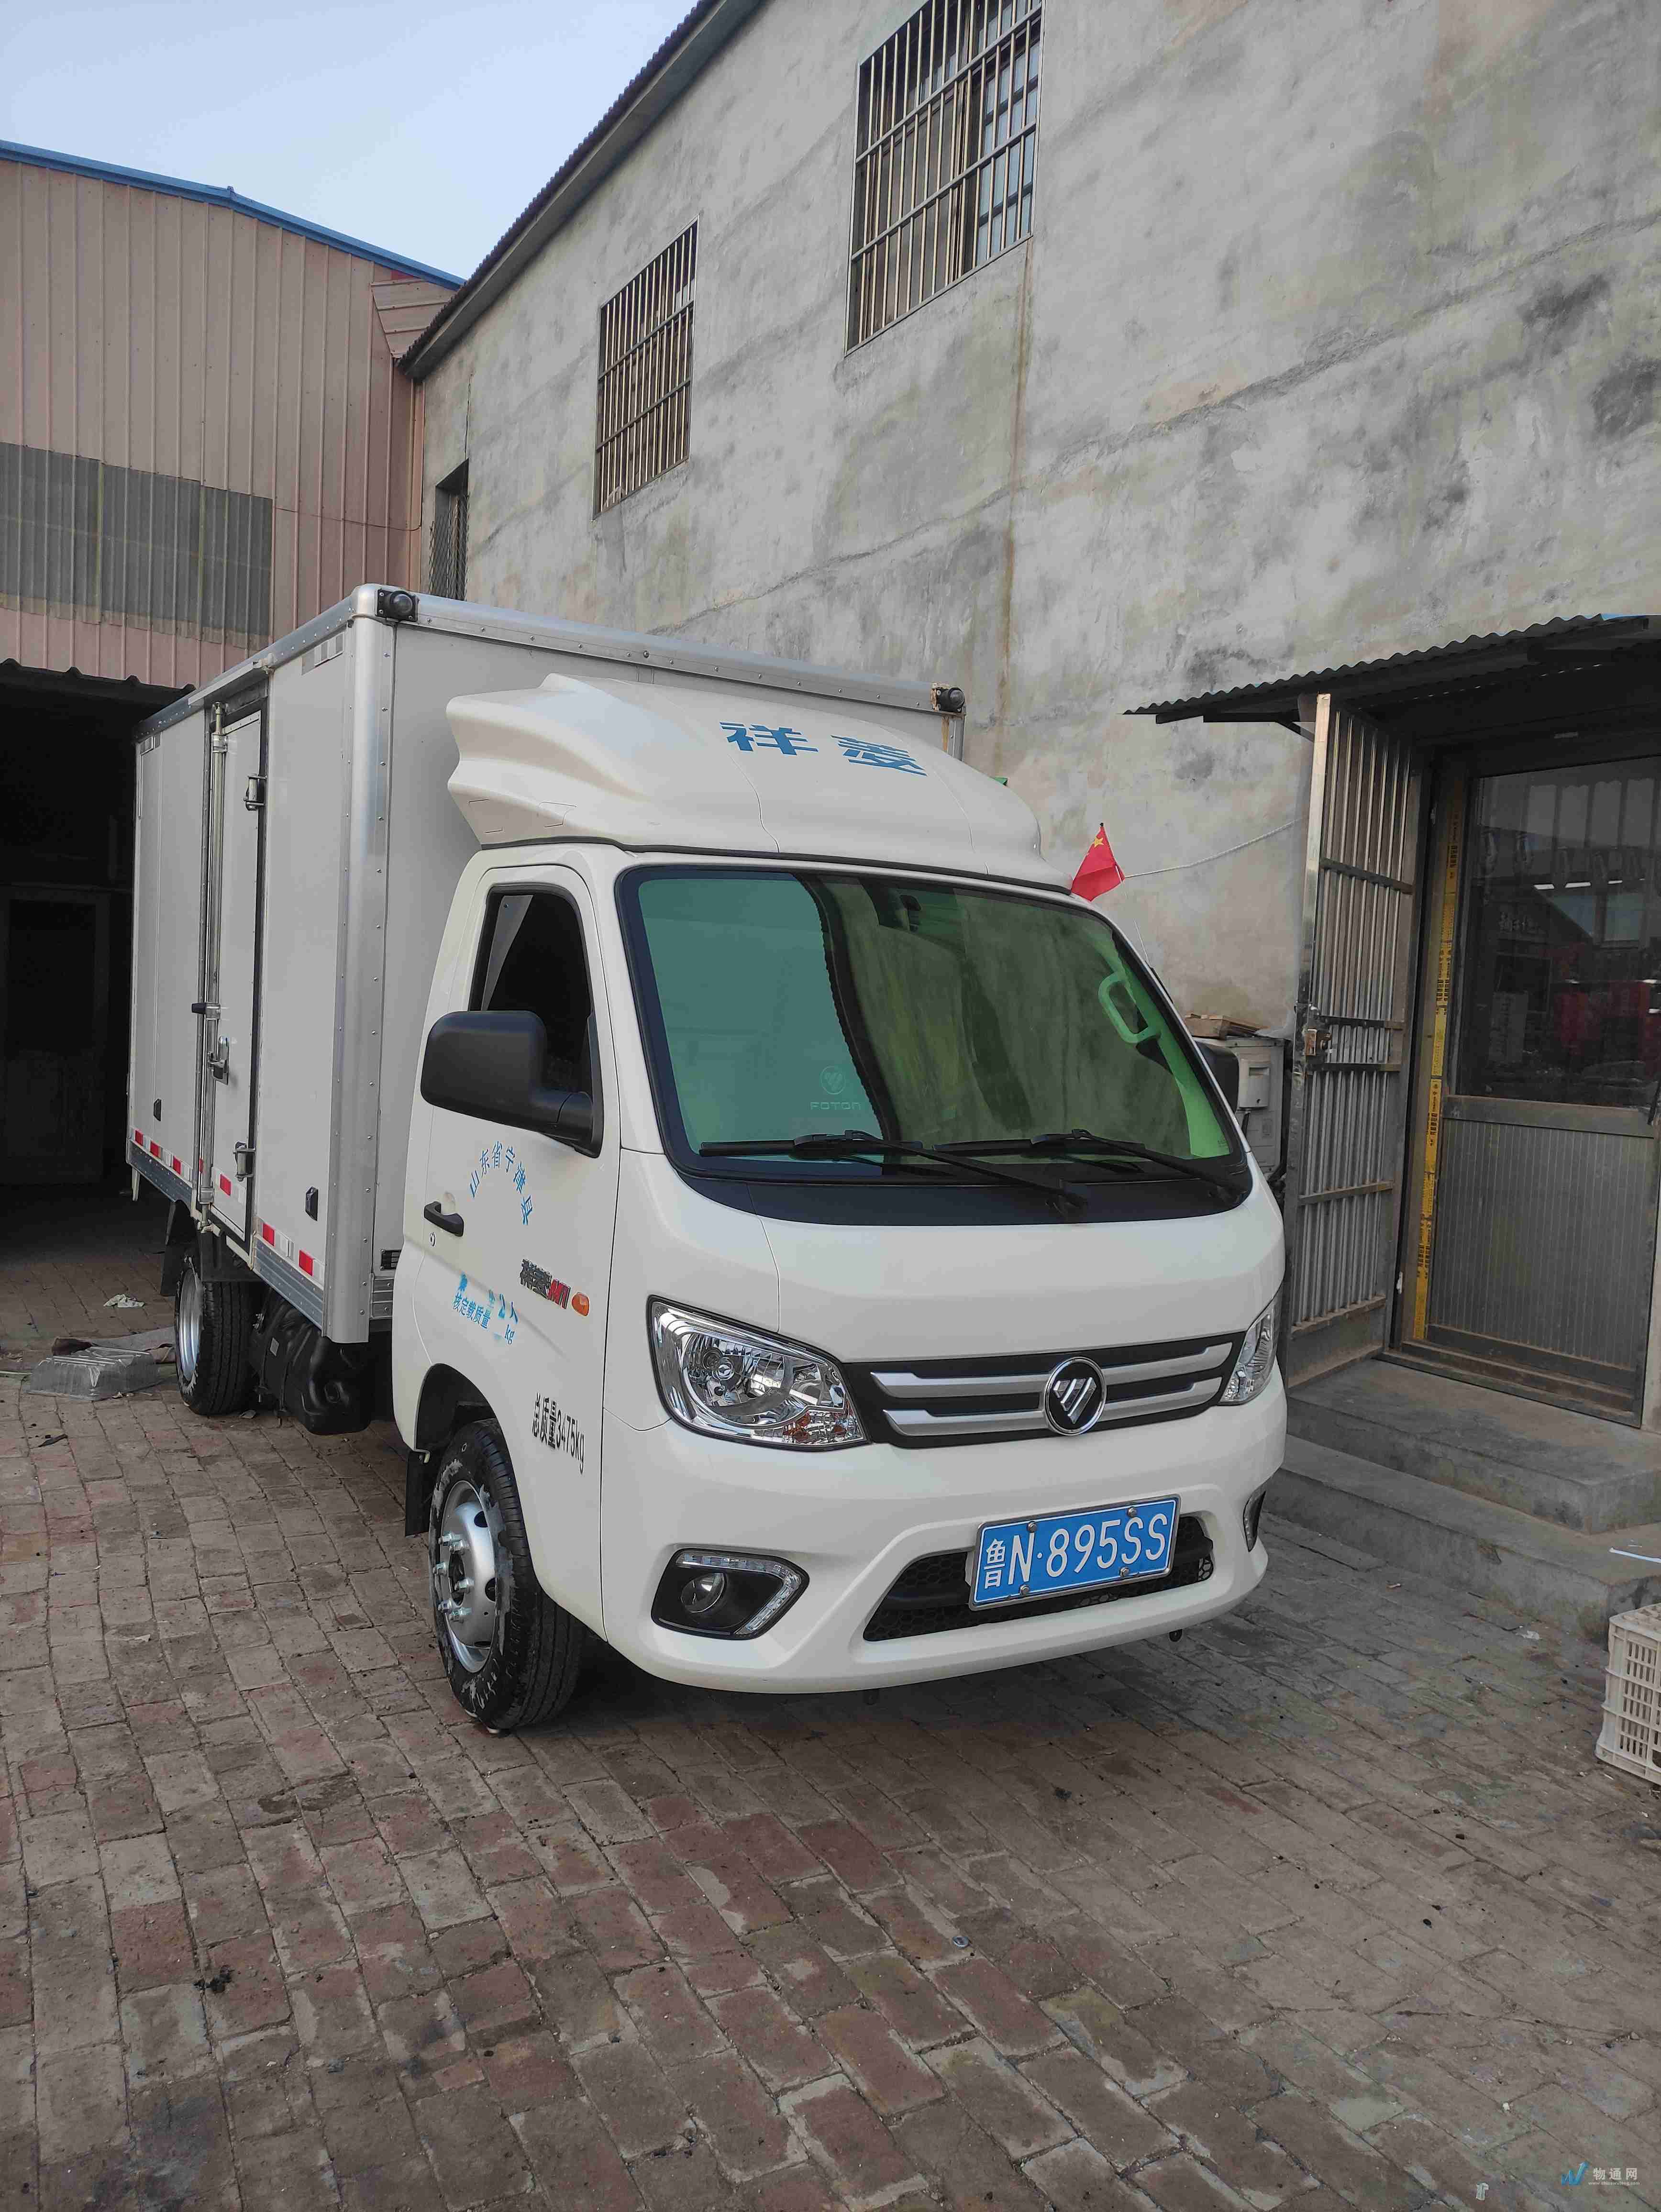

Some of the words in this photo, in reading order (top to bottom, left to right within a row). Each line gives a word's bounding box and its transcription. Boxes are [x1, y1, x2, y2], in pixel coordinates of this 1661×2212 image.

[453, 1292, 490, 1329] 核定载质量
[505, 1324, 515, 1345] kg
[983, 1513, 1168, 1589] 鲁N·895SS
